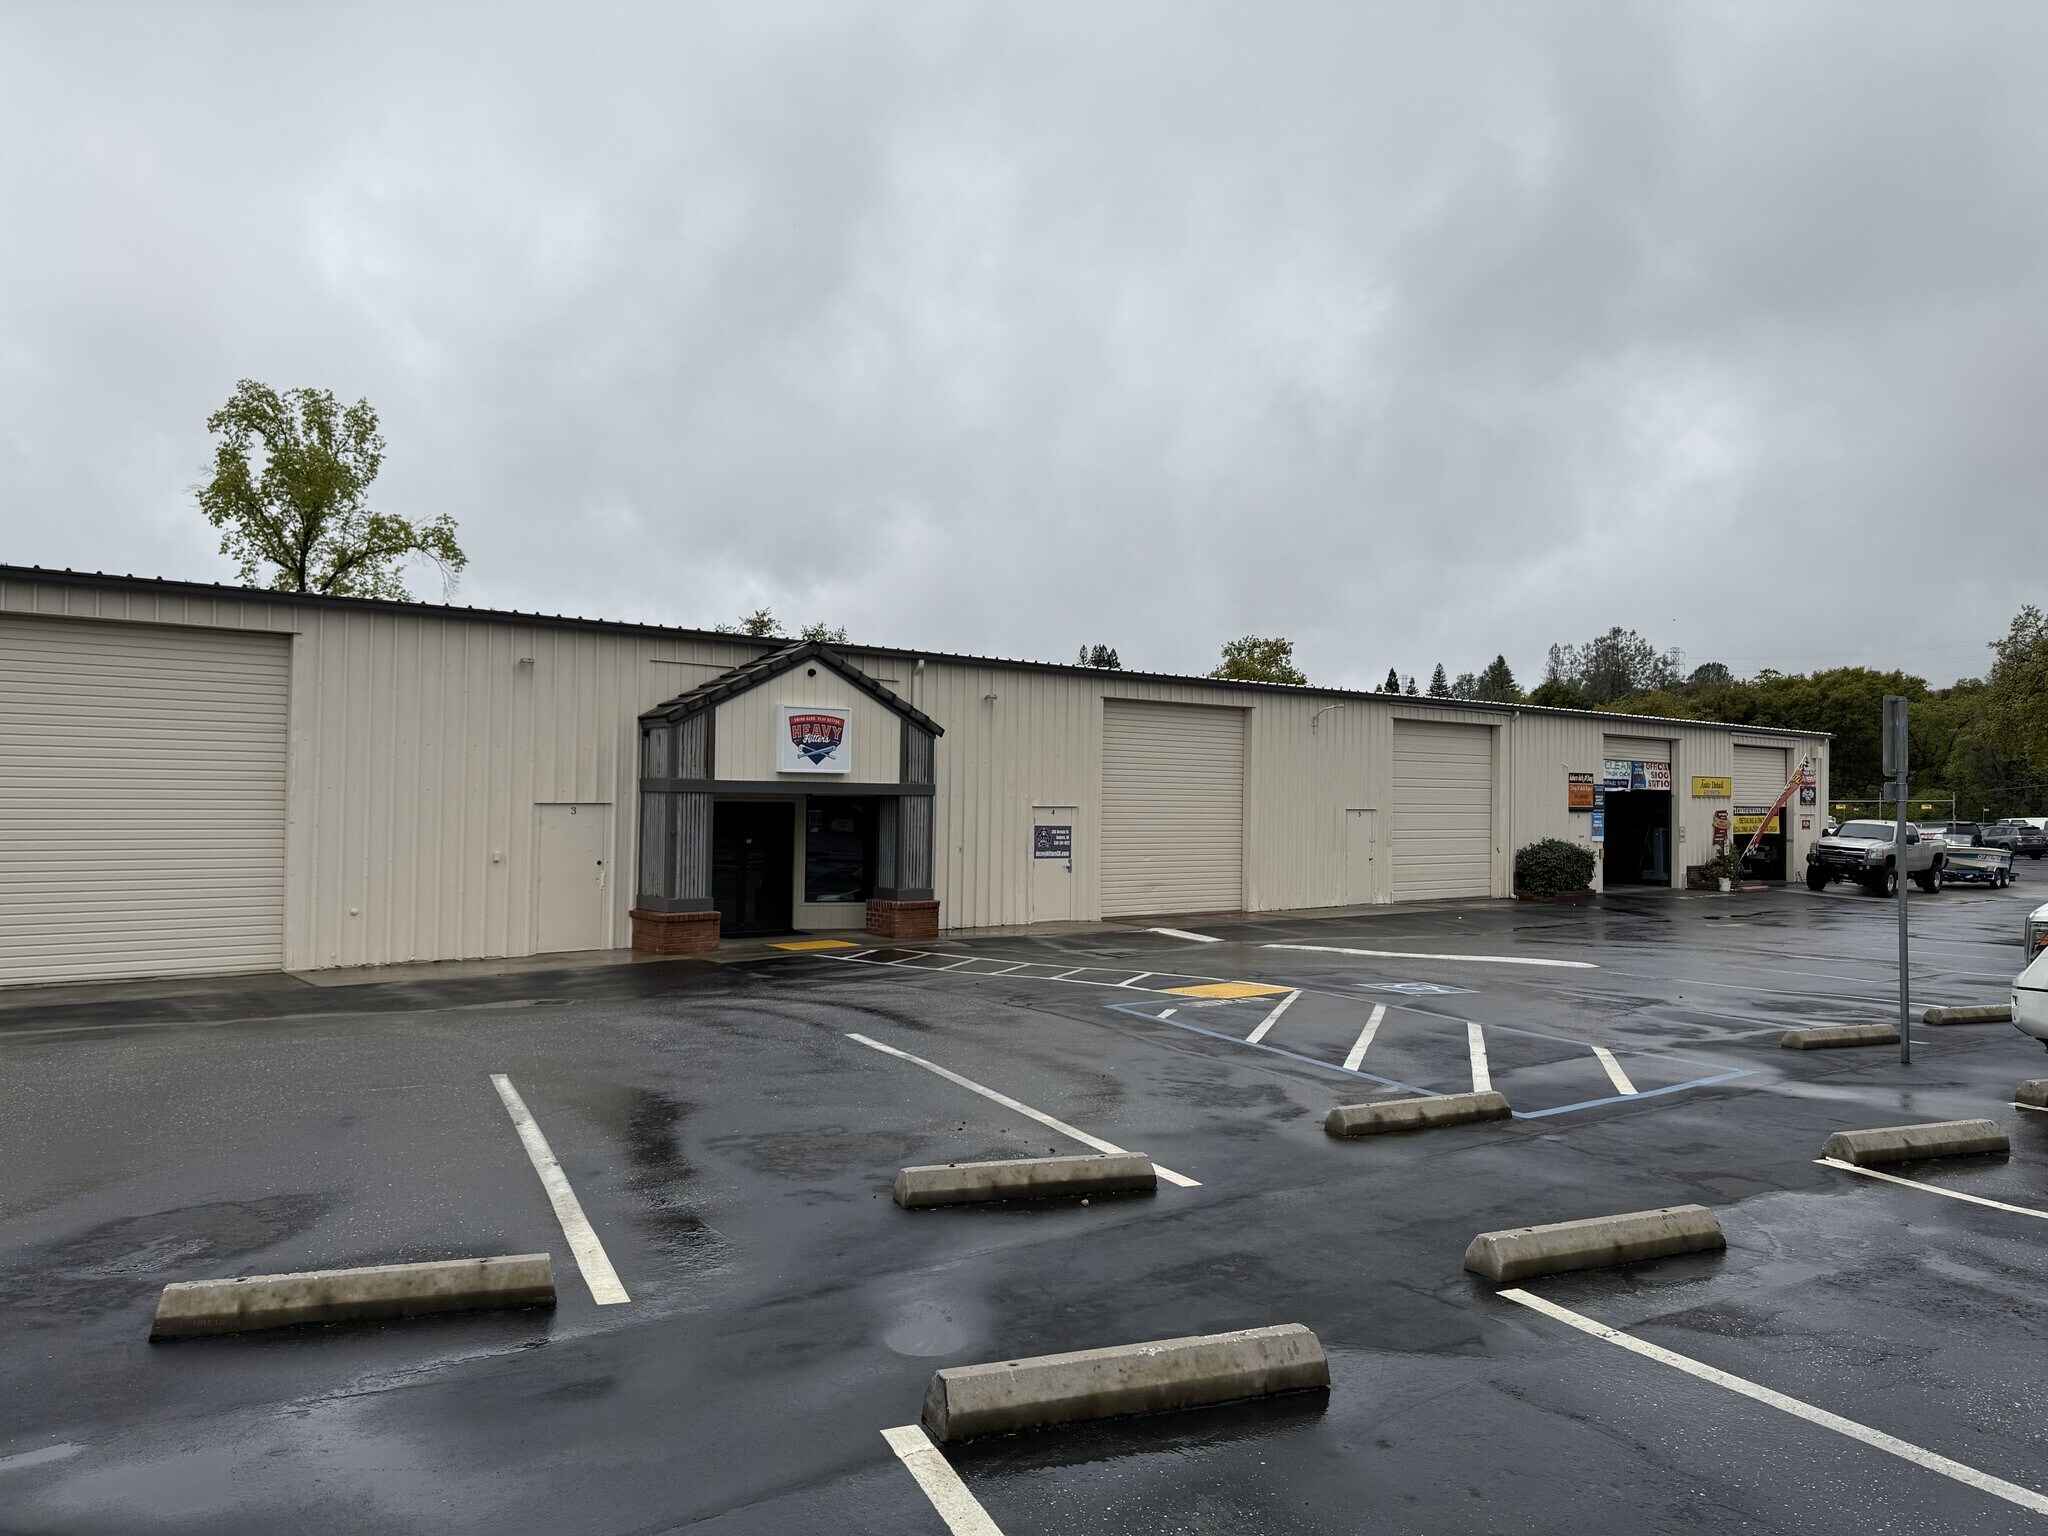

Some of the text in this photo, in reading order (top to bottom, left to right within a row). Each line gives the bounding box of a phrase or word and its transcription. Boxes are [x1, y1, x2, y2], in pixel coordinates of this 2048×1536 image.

[792, 723, 842, 740] HEAVY
[1604, 760, 1631, 770] CLEAN
[1700, 780, 1725, 789] Auto Detail
[570, 806, 578, 816] 3
